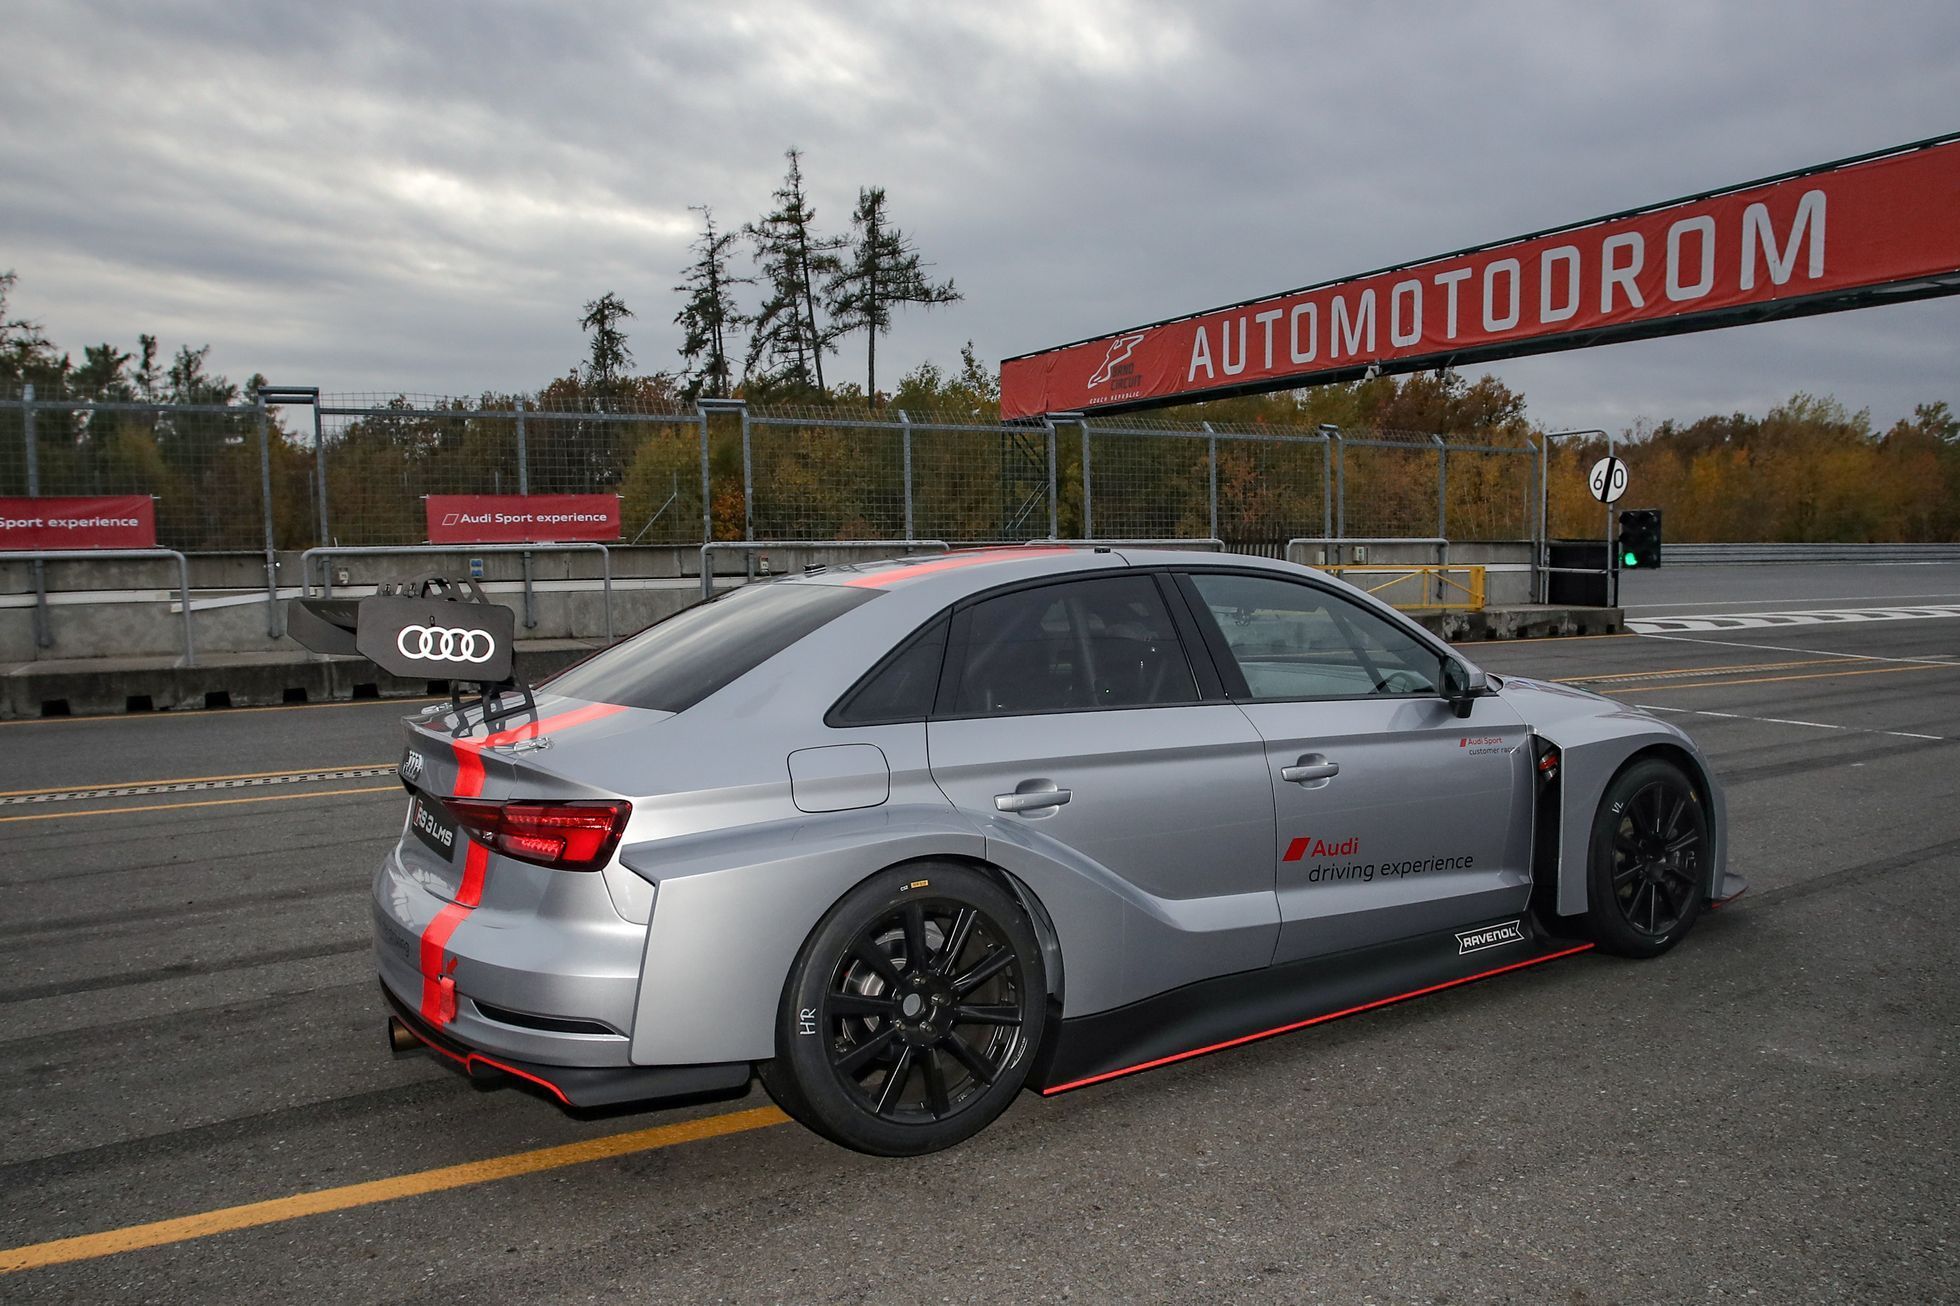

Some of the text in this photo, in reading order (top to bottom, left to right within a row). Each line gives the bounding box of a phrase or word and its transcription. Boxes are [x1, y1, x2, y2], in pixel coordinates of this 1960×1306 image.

[1187, 189, 1827, 383] AUTOMOTODROM
[1593, 468, 1624, 491] 60
[47, 516, 139, 530] experience
[460, 512, 607, 524] Audi Sport experience
[1468, 747, 1500, 755] customer
[1484, 737, 1502, 745] Sport
[425, 814, 435, 834] 3
[432, 822, 453, 847] LMS
[1311, 837, 1359, 857] Audi
[1309, 855, 1474, 882] driving experience
[1463, 928, 1516, 947] RAVENOL
[800, 1008, 816, 1034] HR
